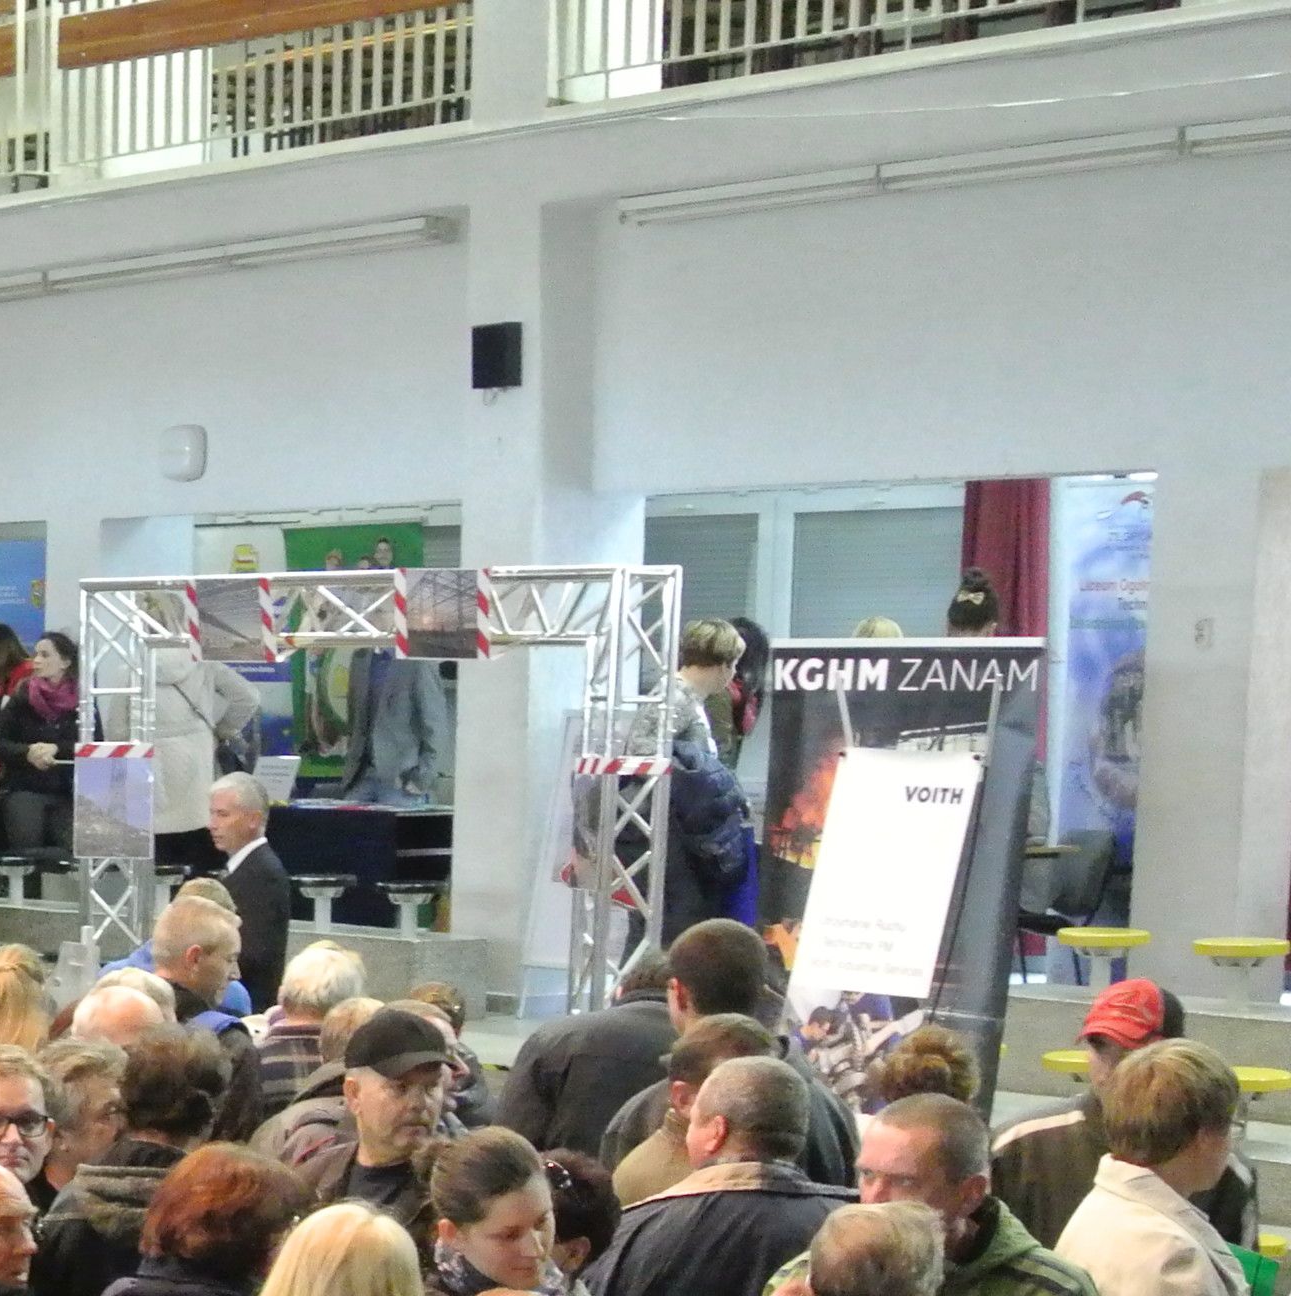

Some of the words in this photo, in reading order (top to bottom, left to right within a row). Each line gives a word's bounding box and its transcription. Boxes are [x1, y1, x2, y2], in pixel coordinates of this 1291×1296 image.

[774, 657, 889, 691] KGHM
[897, 658, 1039, 691] ZANAM
[905, 786, 964, 804] VOITH
